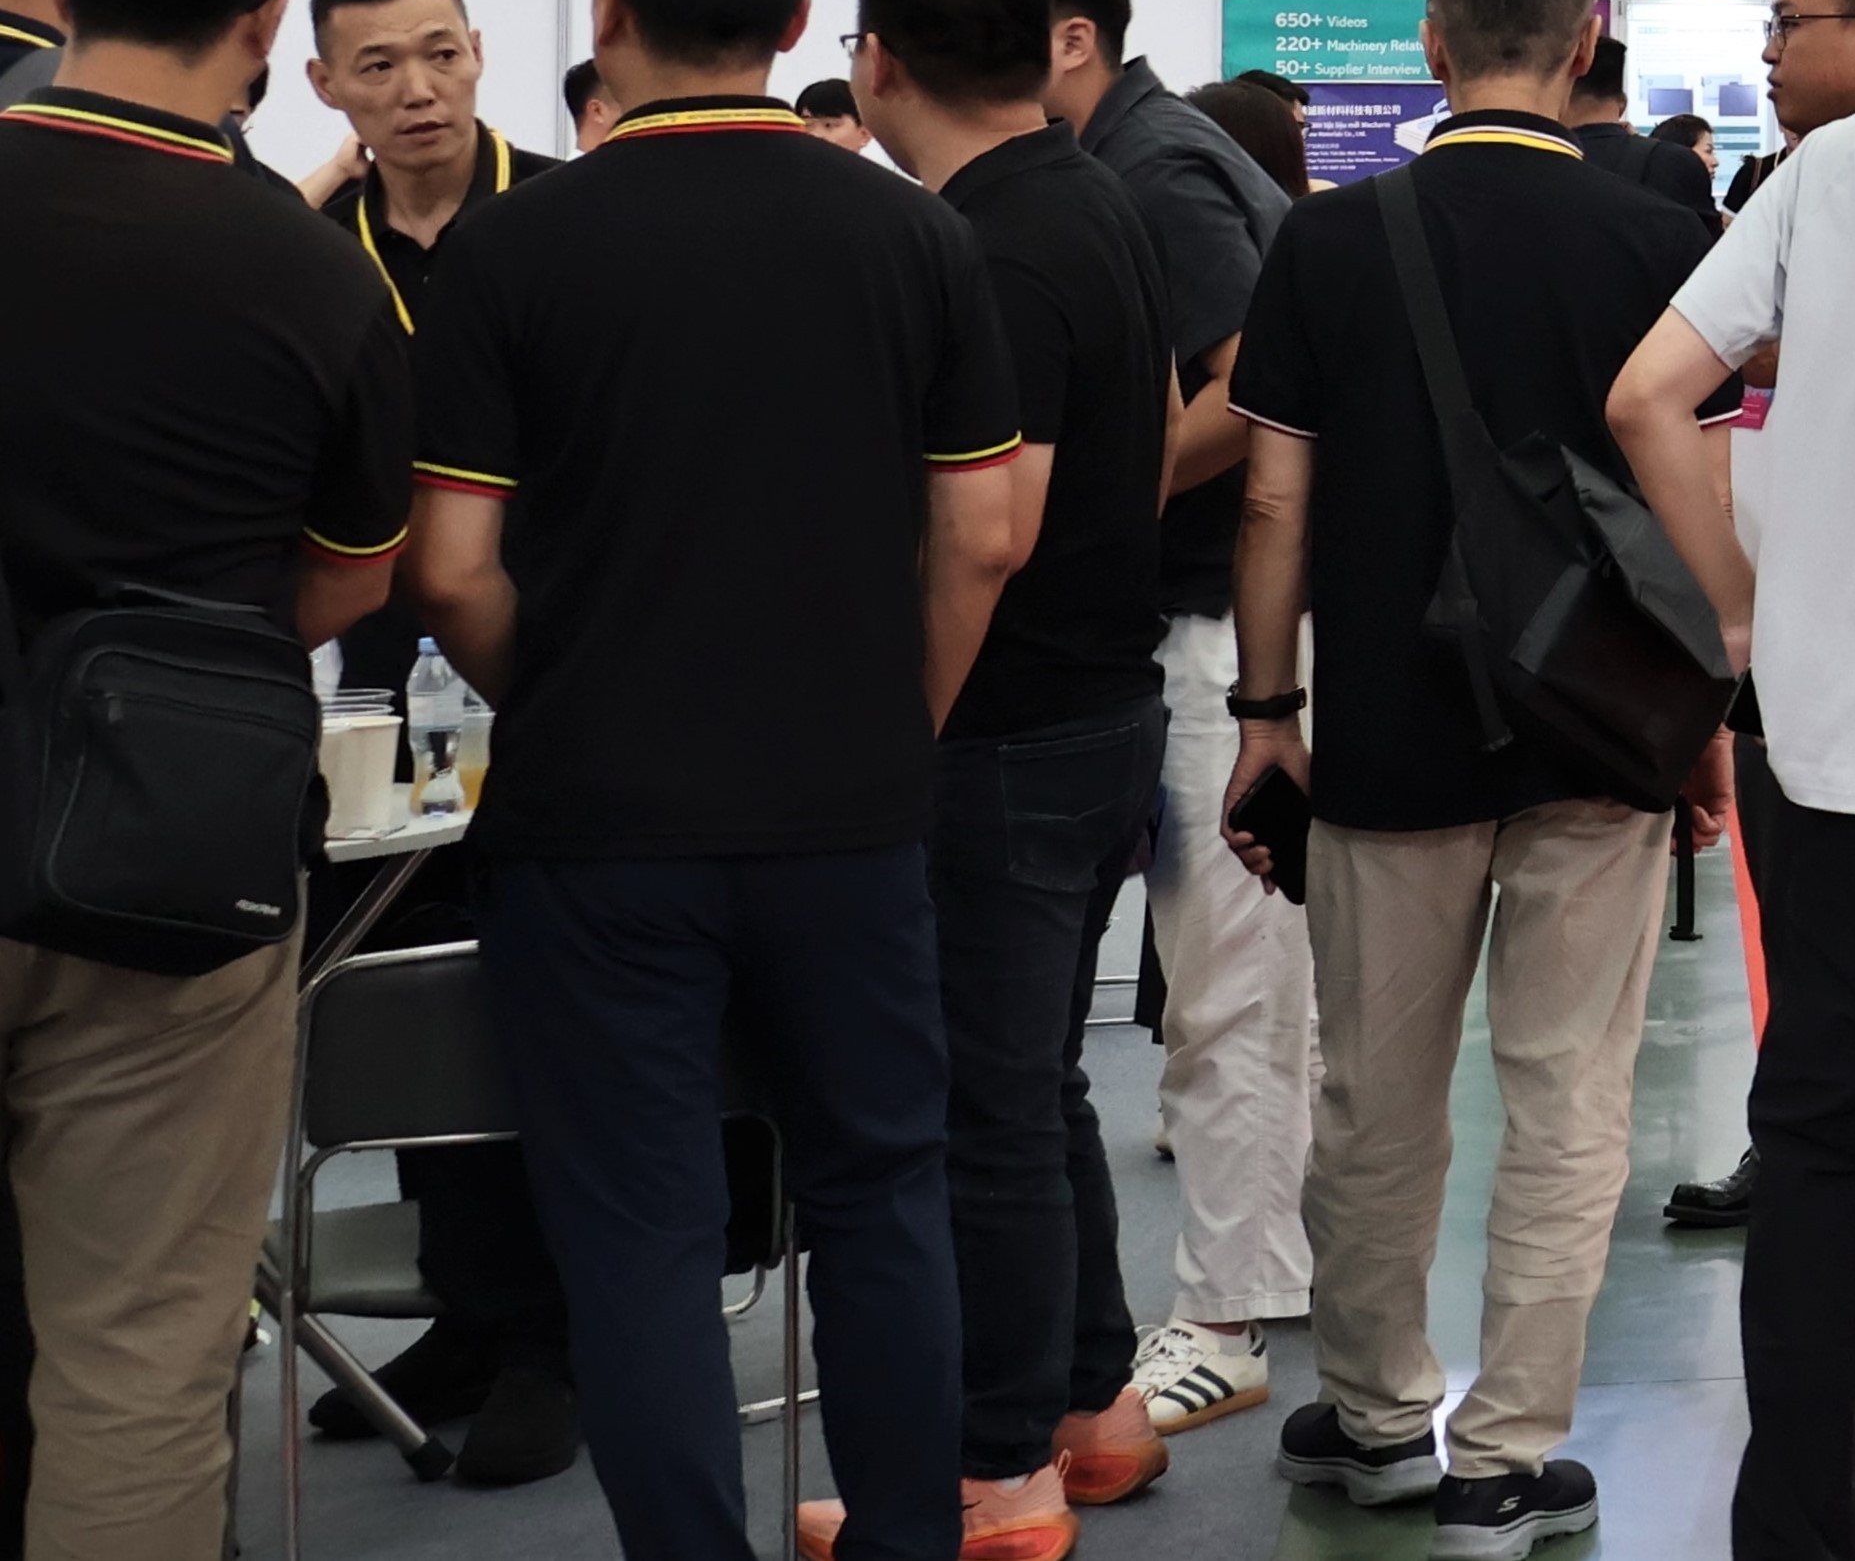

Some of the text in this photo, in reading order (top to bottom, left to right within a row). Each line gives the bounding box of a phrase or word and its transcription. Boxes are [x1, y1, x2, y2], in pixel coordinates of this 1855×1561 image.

[1276, 13, 1368, 28] 650+ Videos
[1276, 37, 1386, 55] 220+ Machinery
[1276, 60, 1420, 77] 50+ Supplier Interview
